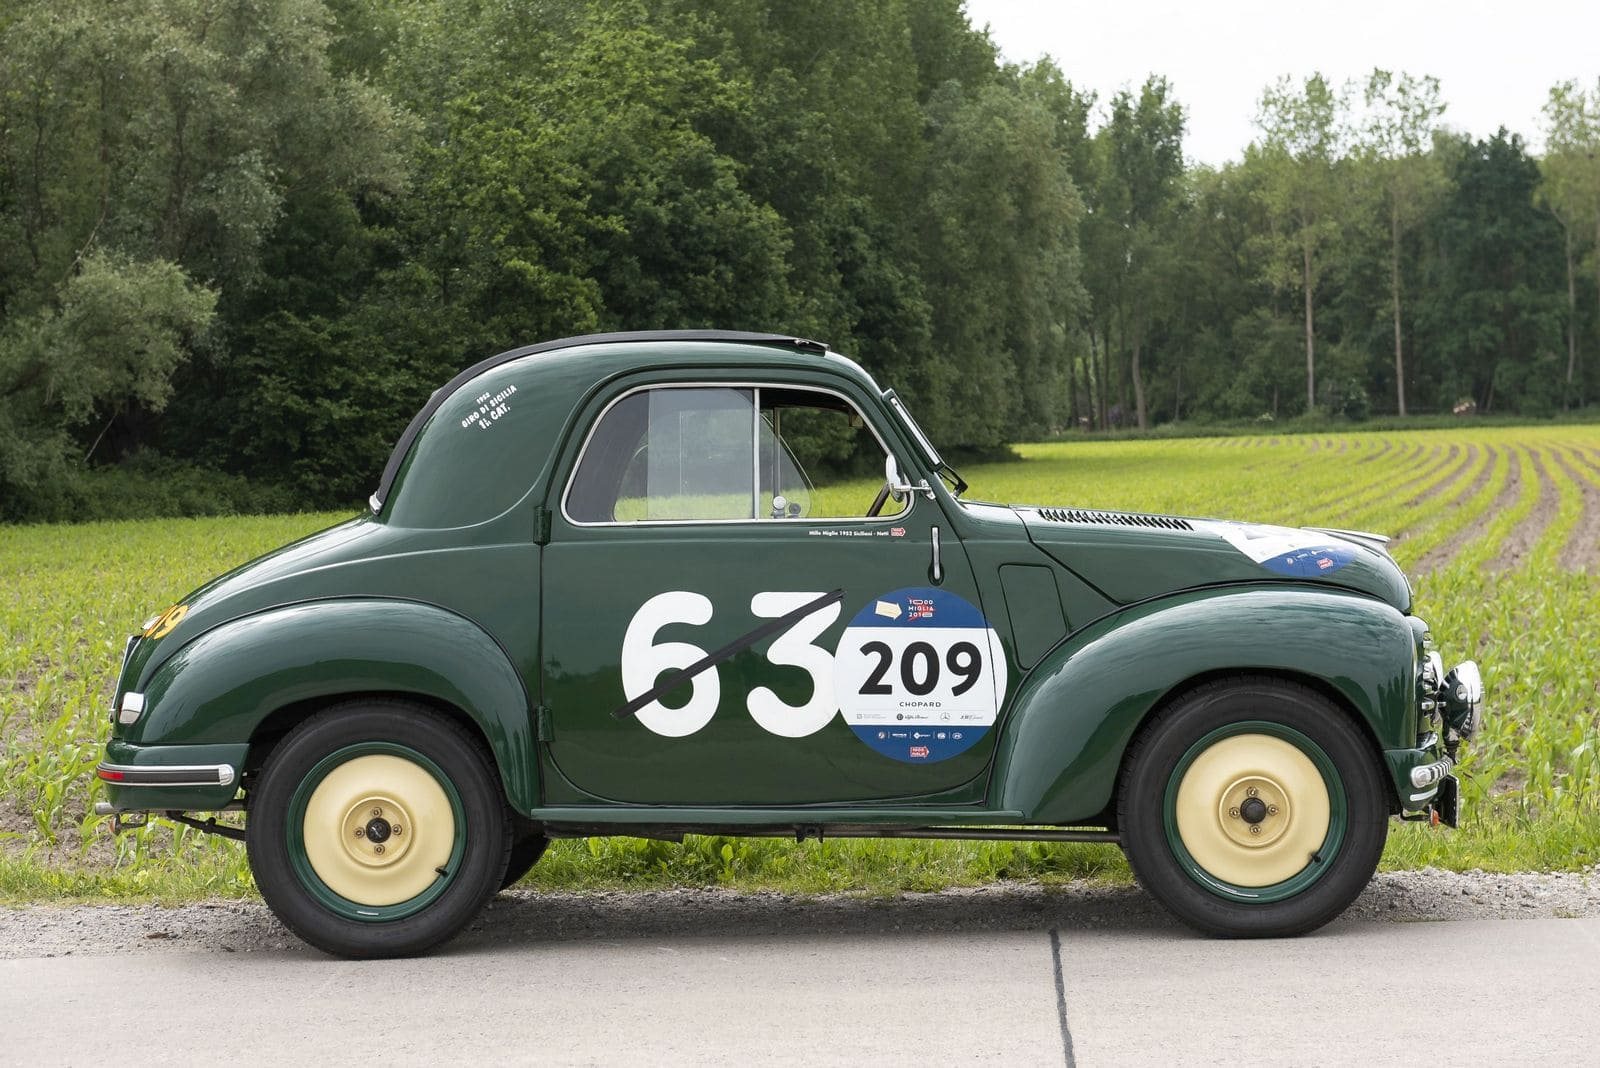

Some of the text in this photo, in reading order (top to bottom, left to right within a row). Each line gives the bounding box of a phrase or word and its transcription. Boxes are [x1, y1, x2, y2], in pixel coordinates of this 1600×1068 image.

[462, 385, 516, 427] GIRO DI SICILIA
[490, 403, 510, 420] CAT.
[621, 590, 841, 738] 63
[858, 640, 982, 697] 209
